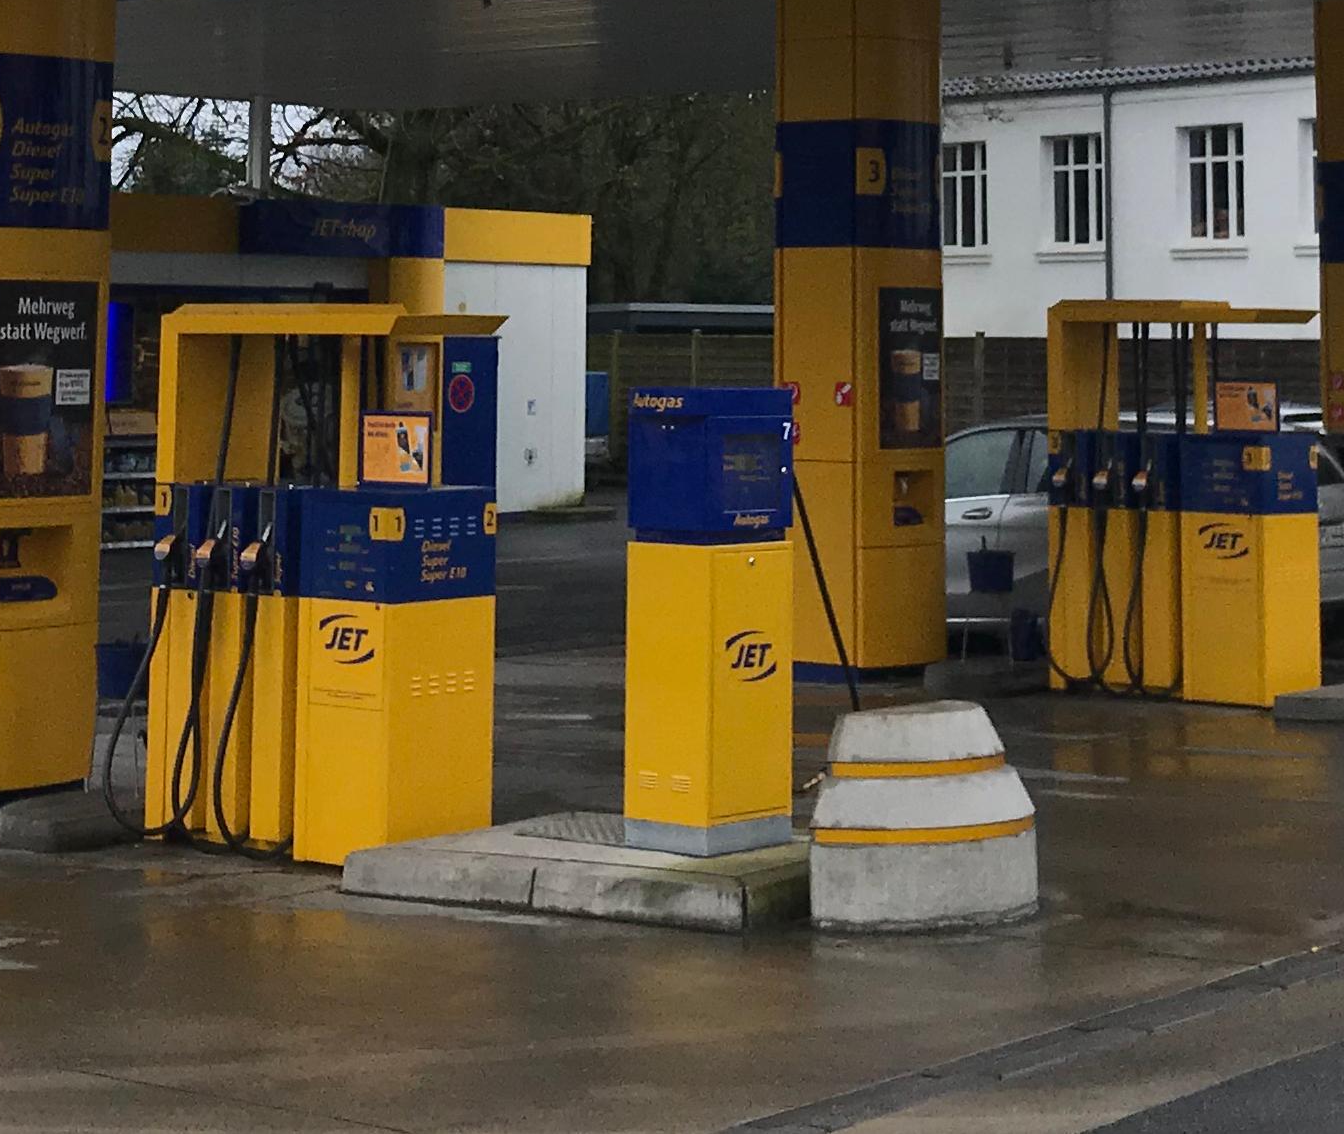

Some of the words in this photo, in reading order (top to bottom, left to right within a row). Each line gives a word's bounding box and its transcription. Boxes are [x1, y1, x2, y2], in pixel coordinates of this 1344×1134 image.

[11, 116, 74, 141] Autogas
[11, 139, 64, 159] Diesel
[9, 163, 58, 185] Super
[869, 159, 881, 183] 3
[9, 185, 58, 207] Super
[311, 218, 341, 237] JET
[342, 218, 377, 243] shop
[17, 296, 75, 320] Mehrweg
[0, 323, 32, 340] statt
[33, 322, 88, 345] Wegwerf.
[633, 393, 684, 412] Autogas
[782, 422, 792, 441] 7
[161, 491, 168, 508] 1
[372, 515, 379, 532] 1
[395, 516, 402, 533] 1
[486, 511, 495, 527] 2
[420, 539, 452, 554] Diesel
[1203, 532, 1243, 550] JET
[421, 554, 449, 569] Super
[420, 568, 448, 584] Super
[449, 566, 468, 580] E10
[324, 626, 369, 652] JET
[730, 643, 773, 670] JET
